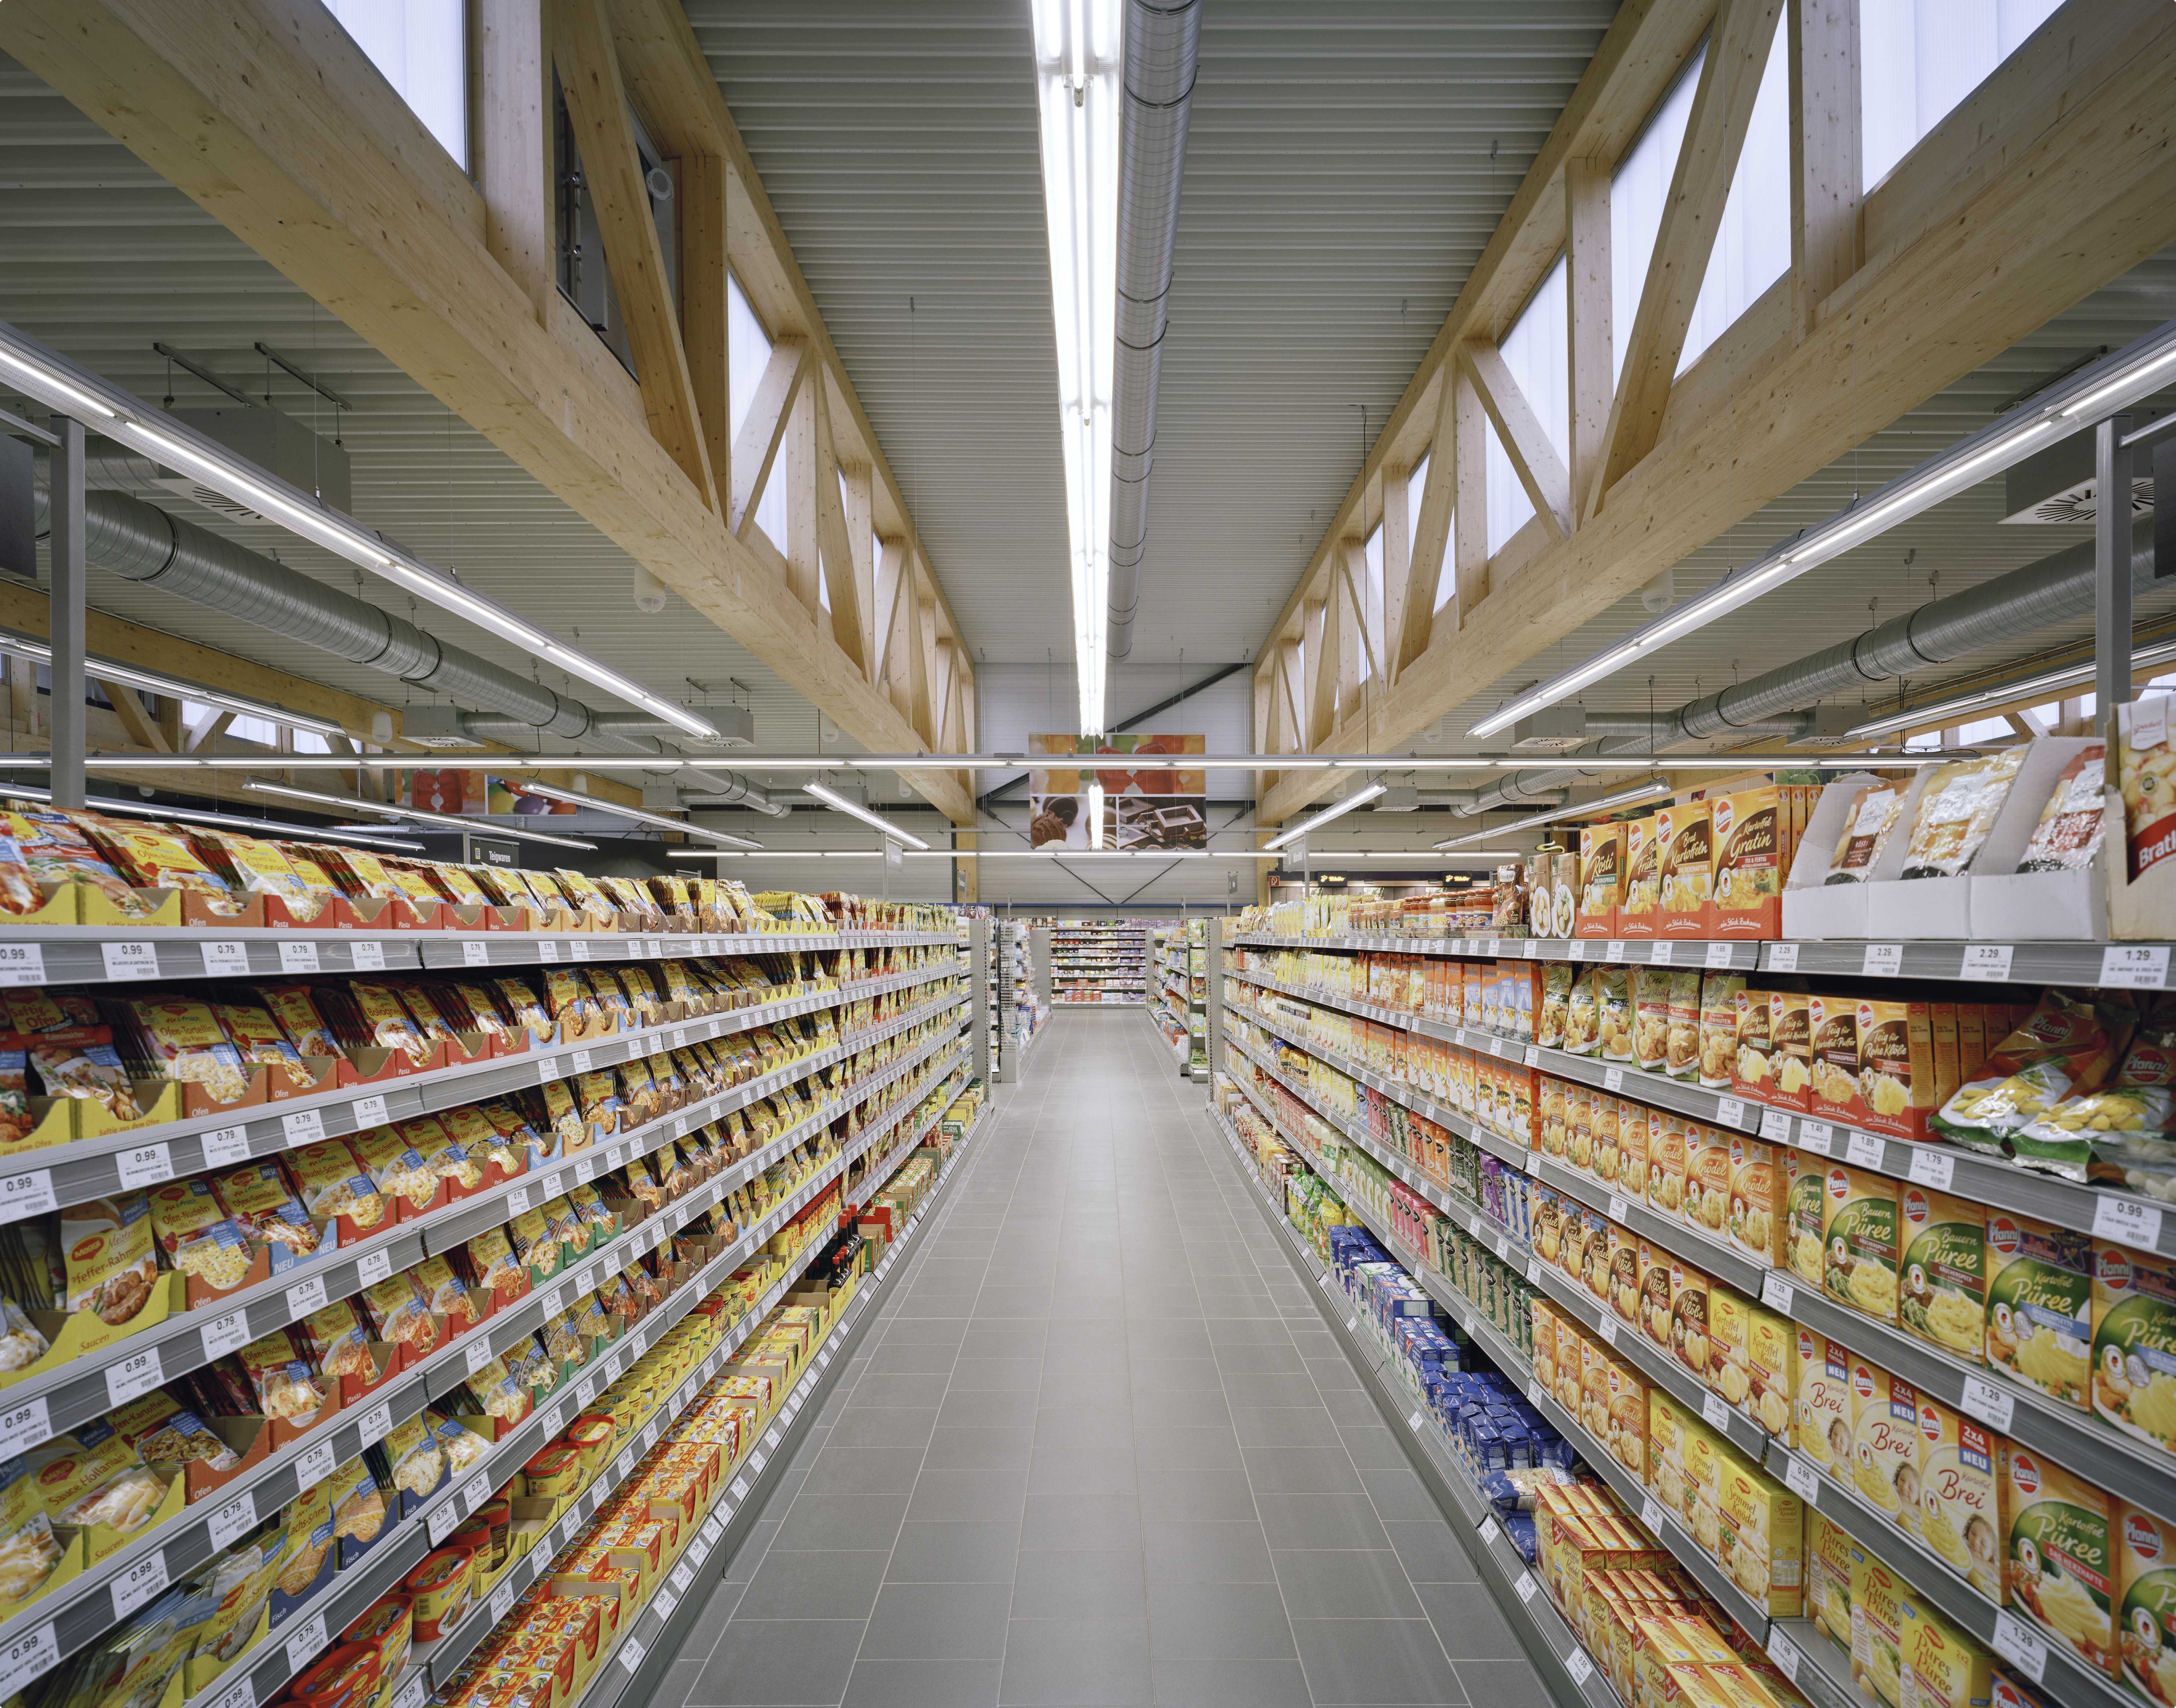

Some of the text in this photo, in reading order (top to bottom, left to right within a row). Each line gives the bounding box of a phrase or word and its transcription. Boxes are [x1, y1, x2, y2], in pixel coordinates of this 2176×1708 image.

[1715, 810, 1732, 826] Pfanni
[1658, 819, 1672, 835] Pfanni
[1744, 816, 1772, 836] Kartoffel
[1683, 832, 1696, 844] Brat
[489, 851, 510, 863] Teigwaren
[1671, 843, 1707, 867] Kartoffeln
[1729, 835, 1772, 865] Gratin
[1591, 852, 1614, 880] Rösti
[0, 949, 25, 959] 0.99
[122, 945, 142, 955] 0.99
[217, 945, 235, 953] 0.79
[292, 945, 307, 953] 0.79
[1877, 948, 1891, 956] 2.29
[1980, 949, 1999, 958] 2.29
[2126, 950, 2150, 960] 1.29
[1826, 1024, 1840, 1037] Teig
[1865, 1044, 1906, 1057] Rohe Klöße
[364, 1100, 377, 1109] 0.79
[1727, 1101, 1737, 1109] 1.89
[192, 1108, 208, 1117] Ofen
[1772, 1114, 1783, 1123] 1.89
[217, 1130, 234, 1141] 0.79
[1811, 1123, 1823, 1133] 1.49
[1861, 1136, 1874, 1147] 1.89
[136, 1150, 156, 1162] 0.99
[1926, 1153, 1942, 1165] 1.79
[310, 1159, 354, 1179] Nudel-Schinken
[1696, 1162, 1726, 1176] Knödel
[6, 1177, 32, 1192] 0.99
[163, 1206, 210, 1225] Ofen-Nudeln
[2117, 1202, 2142, 1217] 0.99
[401, 1213, 413, 1223] Pasta
[1941, 1228, 1978, 1246] Bauern
[1991, 1227, 2018, 1242] Pfanni
[319, 1240, 335, 1254] NEU
[1921, 1238, 1978, 1270] Püree
[274, 1257, 294, 1274] NEU
[368, 1254, 380, 1266] 0.79
[1774, 1282, 1785, 1293] 1.29
[2035, 1271, 2073, 1289] Kartoffel
[299, 1281, 314, 1295] 0.79
[1688, 1290, 1699, 1302] Rohe
[2010, 1278, 2072, 1314] Püree
[1681, 1299, 1704, 1320] Klöße
[217, 1316, 234, 1330] 0.79
[1713, 1311, 1740, 1334] Kartoffel
[80, 1334, 109, 1351] Saucen
[1721, 1326, 1743, 1346] Knödel
[126, 1356, 146, 1372] 0.99
[1828, 1364, 1845, 1381] NEU
[347, 1392, 361, 1404] Pasta
[1810, 1382, 1844, 1413] Brei
[1981, 1386, 1999, 1401] 1.29
[1713, 1400, 1722, 1410] 1.89
[5, 1408, 30, 1428] 0.99
[368, 1411, 382, 1425] 0.79
[393, 1425, 419, 1442] Seelachs
[1798, 1466, 1809, 1480] 0.99
[194, 1485, 212, 1499] Ofen
[335, 1478, 350, 1492] Gratin
[1938, 1469, 1985, 1509] Brei
[48, 1484, 81, 1506] Sauce
[1726, 1489, 1757, 1516] Semmel
[223, 1502, 241, 1519] 0.79
[1732, 1502, 1758, 1529] Knödel
[1721, 1510, 1739, 1527] Klassisch
[2059, 1510, 2104, 1539] Kartoffel
[2031, 1513, 2103, 1566] Püree
[537, 1544, 545, 1556] 3.99
[1561, 1546, 1581, 1568] Kartoffel
[346, 1552, 359, 1566] Fisch
[131, 1561, 152, 1582] 0.99
[2063, 1555, 2103, 1588] HERZHAFTE
[497, 1588, 506, 1600] 1.99
[1863, 1574, 1899, 1614] Pures
[272, 1608, 286, 1623] Fisch
[1867, 1593, 1900, 1631] Püree
[299, 1624, 314, 1642] 0.79
[12, 1636, 38, 1660] 0.99
[626, 1643, 634, 1654] 1.09
[1780, 1641, 1791, 1656] 1.49
[1578, 1656, 1587, 1668] 0.55
